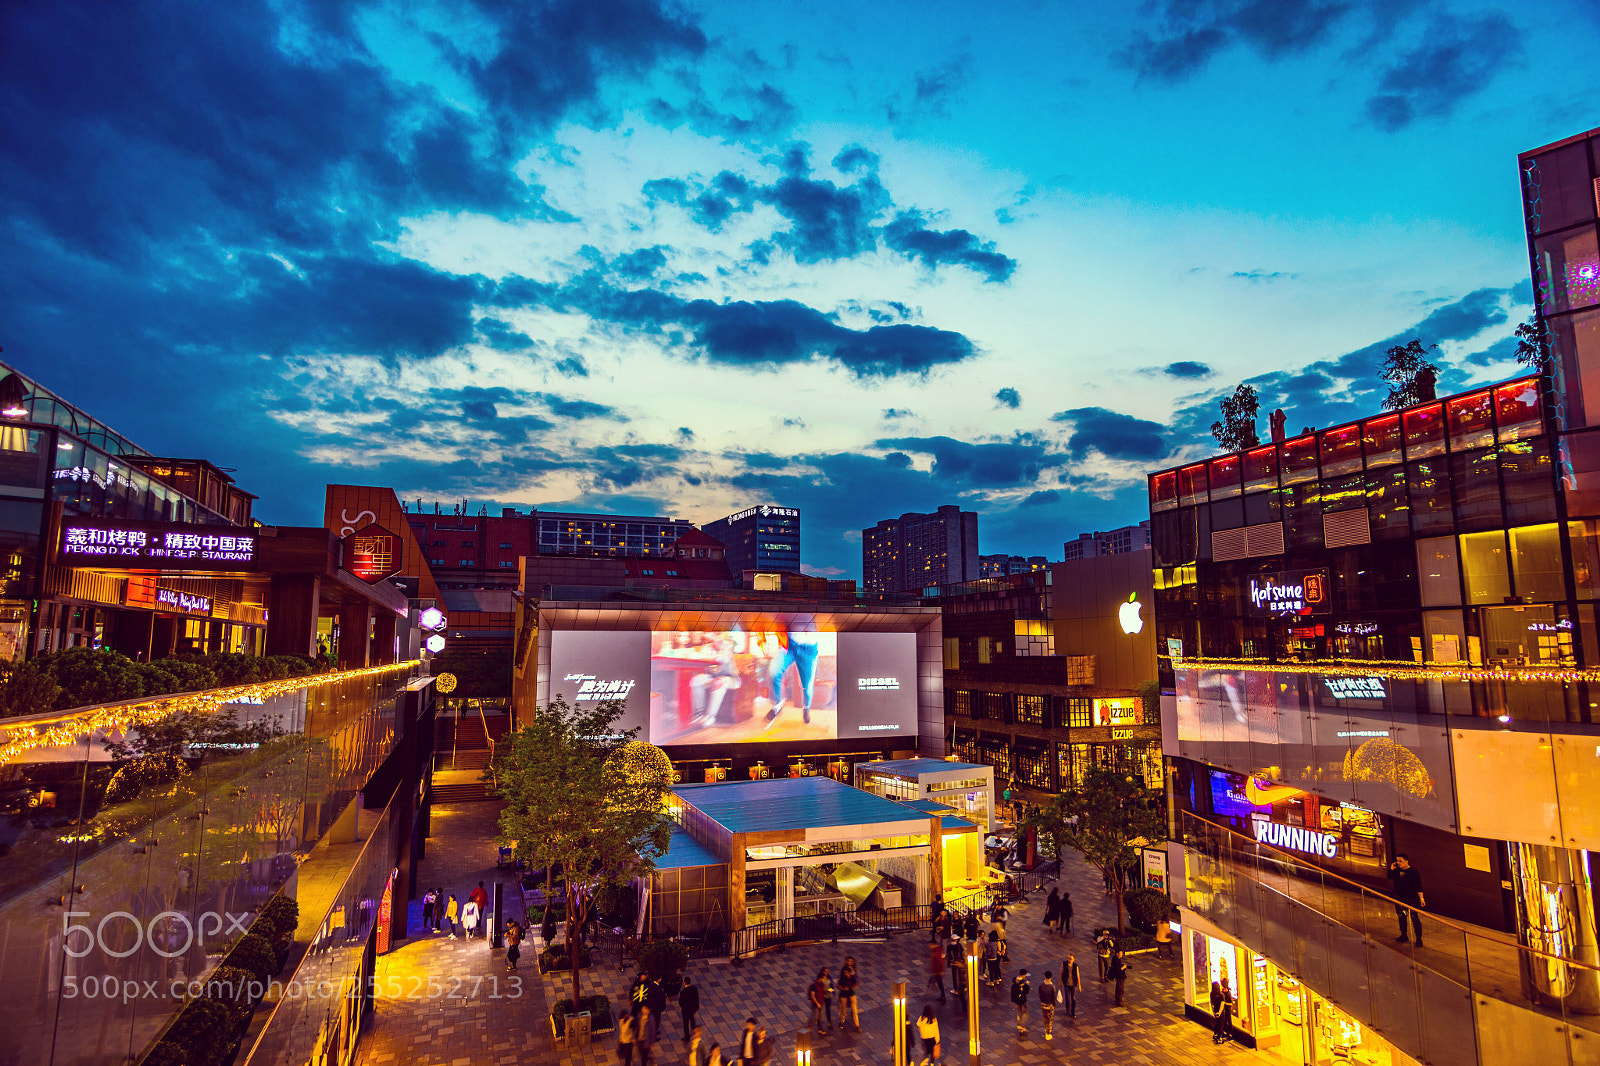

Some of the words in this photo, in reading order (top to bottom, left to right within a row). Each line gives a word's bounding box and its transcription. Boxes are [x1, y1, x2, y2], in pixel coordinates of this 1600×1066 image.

[66, 544, 107, 555] PEKING
[858, 677, 900, 686] DIESEL
[1110, 704, 1134, 718] izzue
[1112, 727, 1134, 740] izzue
[1256, 819, 1338, 859] RUNNING
